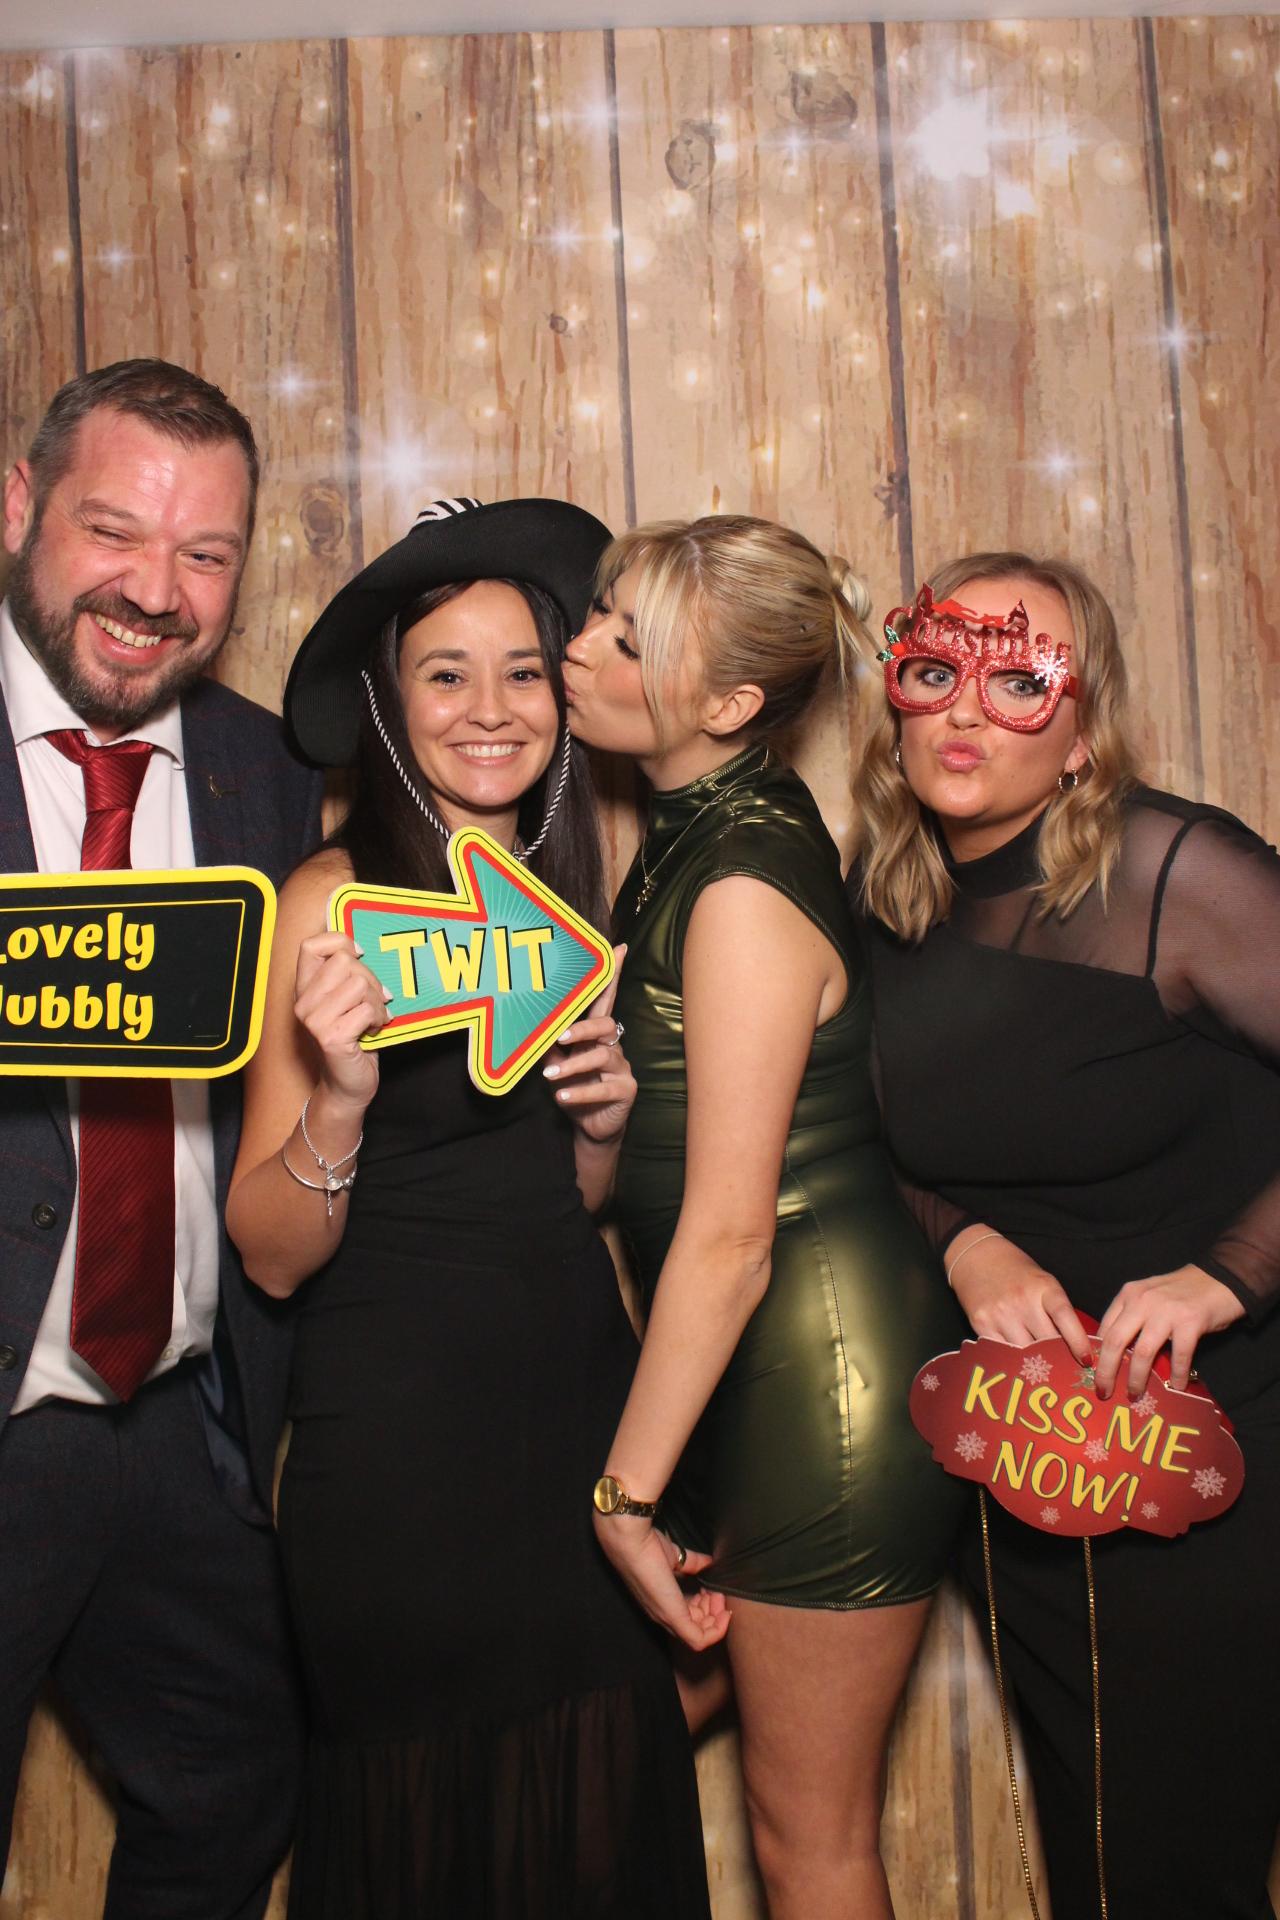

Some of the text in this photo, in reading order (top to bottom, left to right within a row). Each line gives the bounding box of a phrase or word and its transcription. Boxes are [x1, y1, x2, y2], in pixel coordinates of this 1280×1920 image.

[379, 926, 554, 999] TWIT
[0, 982, 154, 1041] ubbly
[963, 1366, 1200, 1473] KISS ME
[991, 1440, 1139, 1522] NOW!
